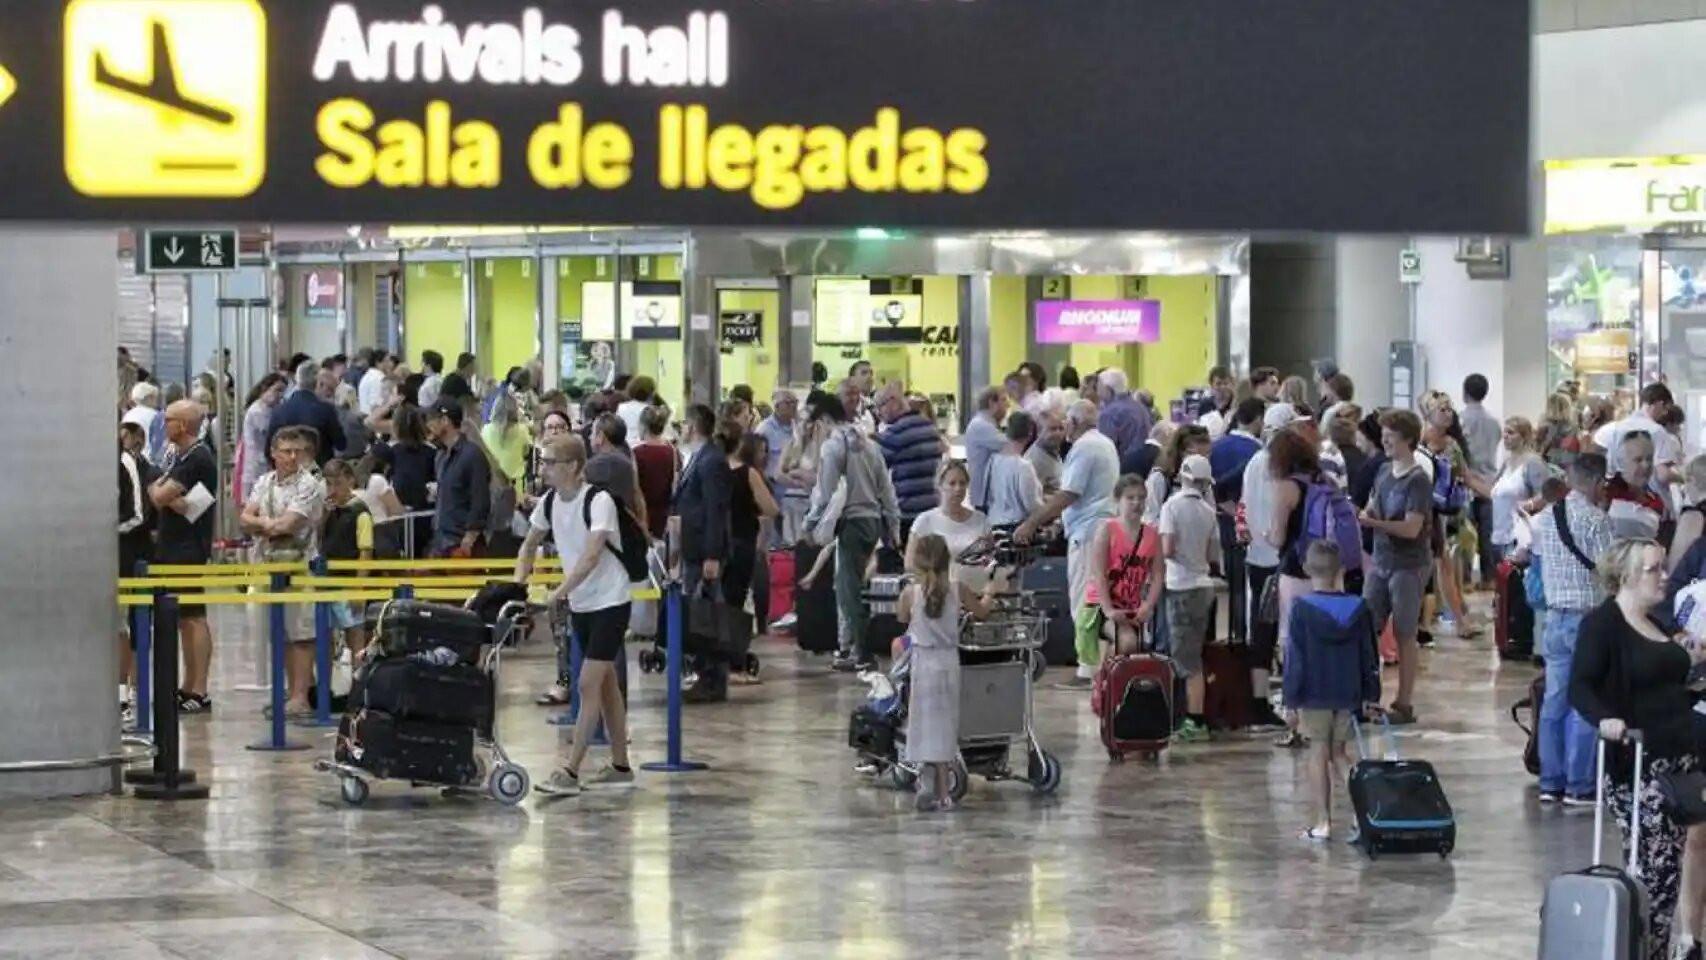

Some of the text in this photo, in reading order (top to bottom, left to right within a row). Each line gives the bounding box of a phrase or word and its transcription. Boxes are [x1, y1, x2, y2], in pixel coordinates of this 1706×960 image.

[312, 3, 729, 88] Arrivals hall
[315, 99, 989, 209] Sala de llegadas
[1048, 279, 1059, 293] 2
